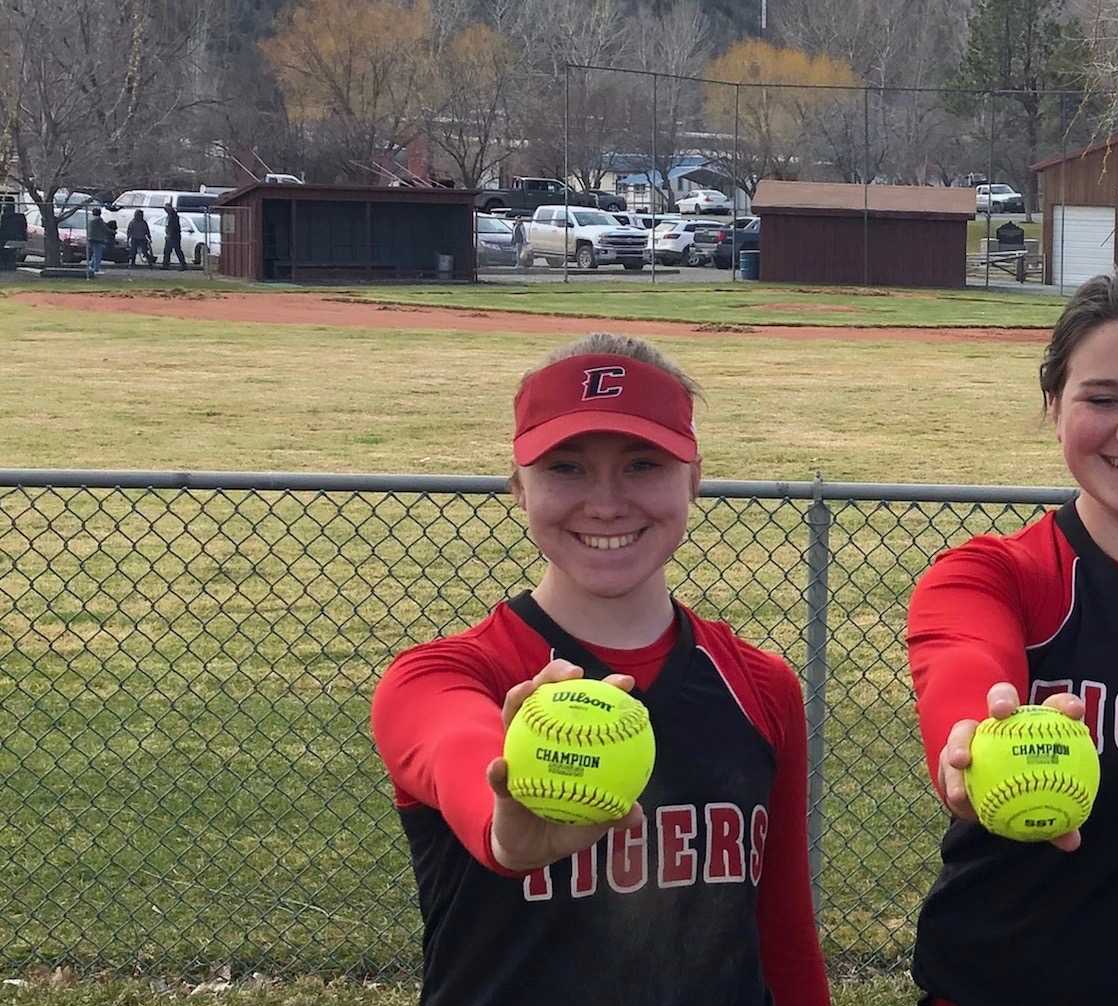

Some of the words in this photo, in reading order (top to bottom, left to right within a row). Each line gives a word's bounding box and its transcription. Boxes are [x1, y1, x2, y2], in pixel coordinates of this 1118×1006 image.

[552, 691, 612, 712] Wilson
[536, 747, 600, 768] CHAMPION
[1012, 743, 1070, 756] CHAMPION
